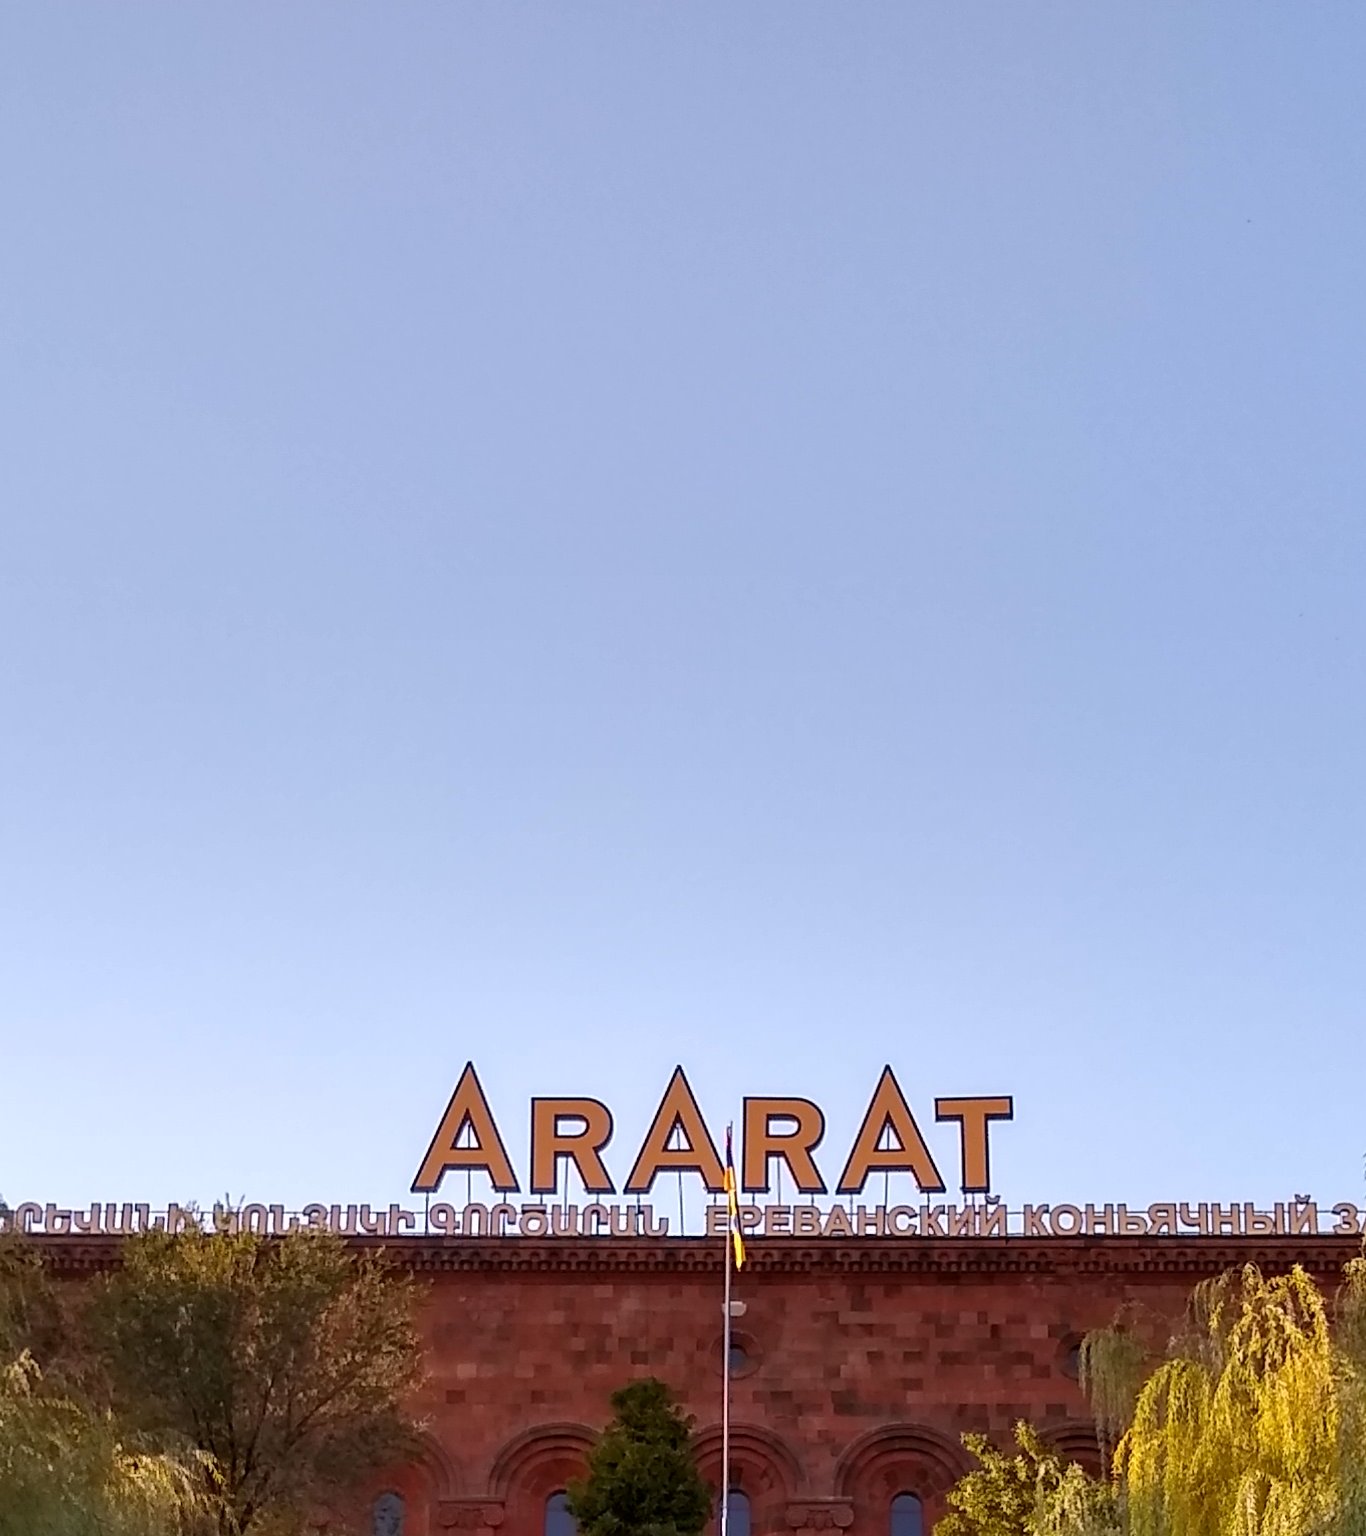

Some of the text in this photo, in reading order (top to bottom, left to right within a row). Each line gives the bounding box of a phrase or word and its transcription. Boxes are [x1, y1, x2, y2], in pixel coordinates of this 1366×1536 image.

[411, 1060, 1014, 1194] ARARAT
[430, 1203, 669, 1236] ԳՈՐԾԱՐԱՆ
[706, 1195, 1007, 1237] ЕРЕВАНСКИЙ
[1023, 1194, 1317, 1236] КОНЬЯЧНЫЙ
